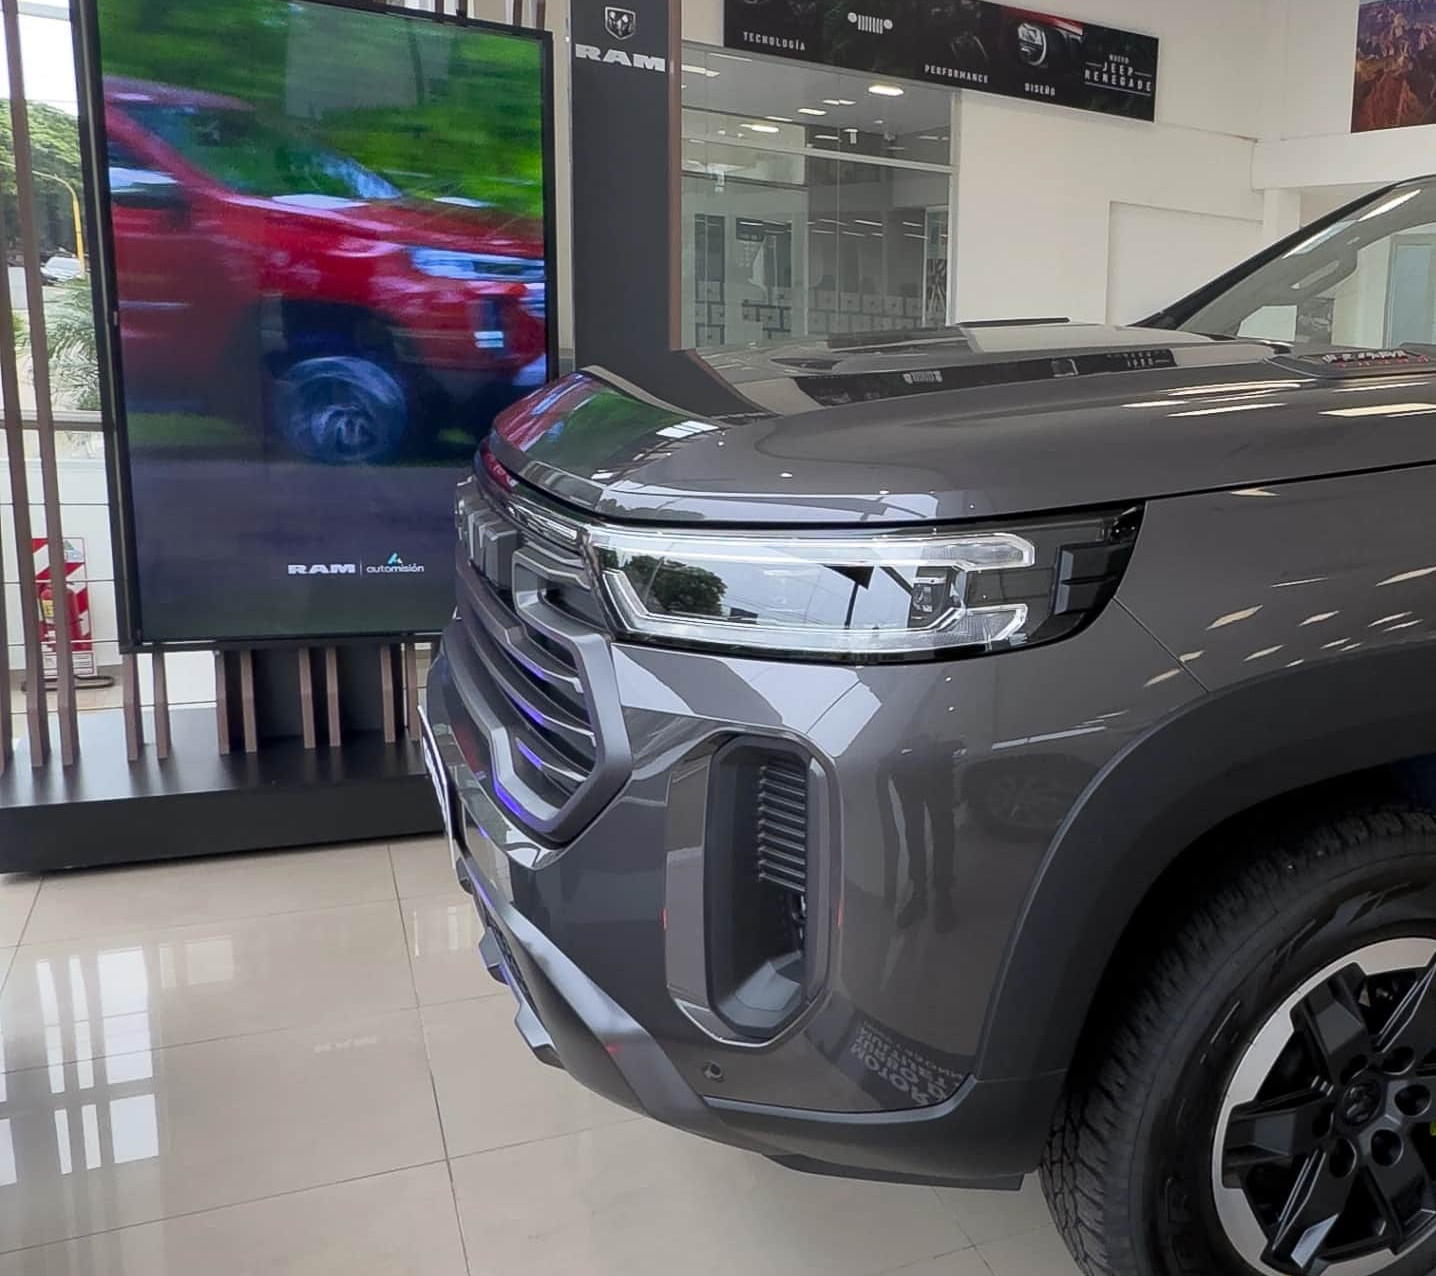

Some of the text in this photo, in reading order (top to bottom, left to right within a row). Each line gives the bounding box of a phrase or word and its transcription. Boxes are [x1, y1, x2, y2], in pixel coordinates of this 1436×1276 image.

[575, 43, 666, 73] RAM
[924, 64, 989, 84] PERFORMANCE
[1102, 61, 1134, 76] JEEP
[1084, 69, 1152, 92] RENEGADE
[287, 564, 356, 575] RAM
